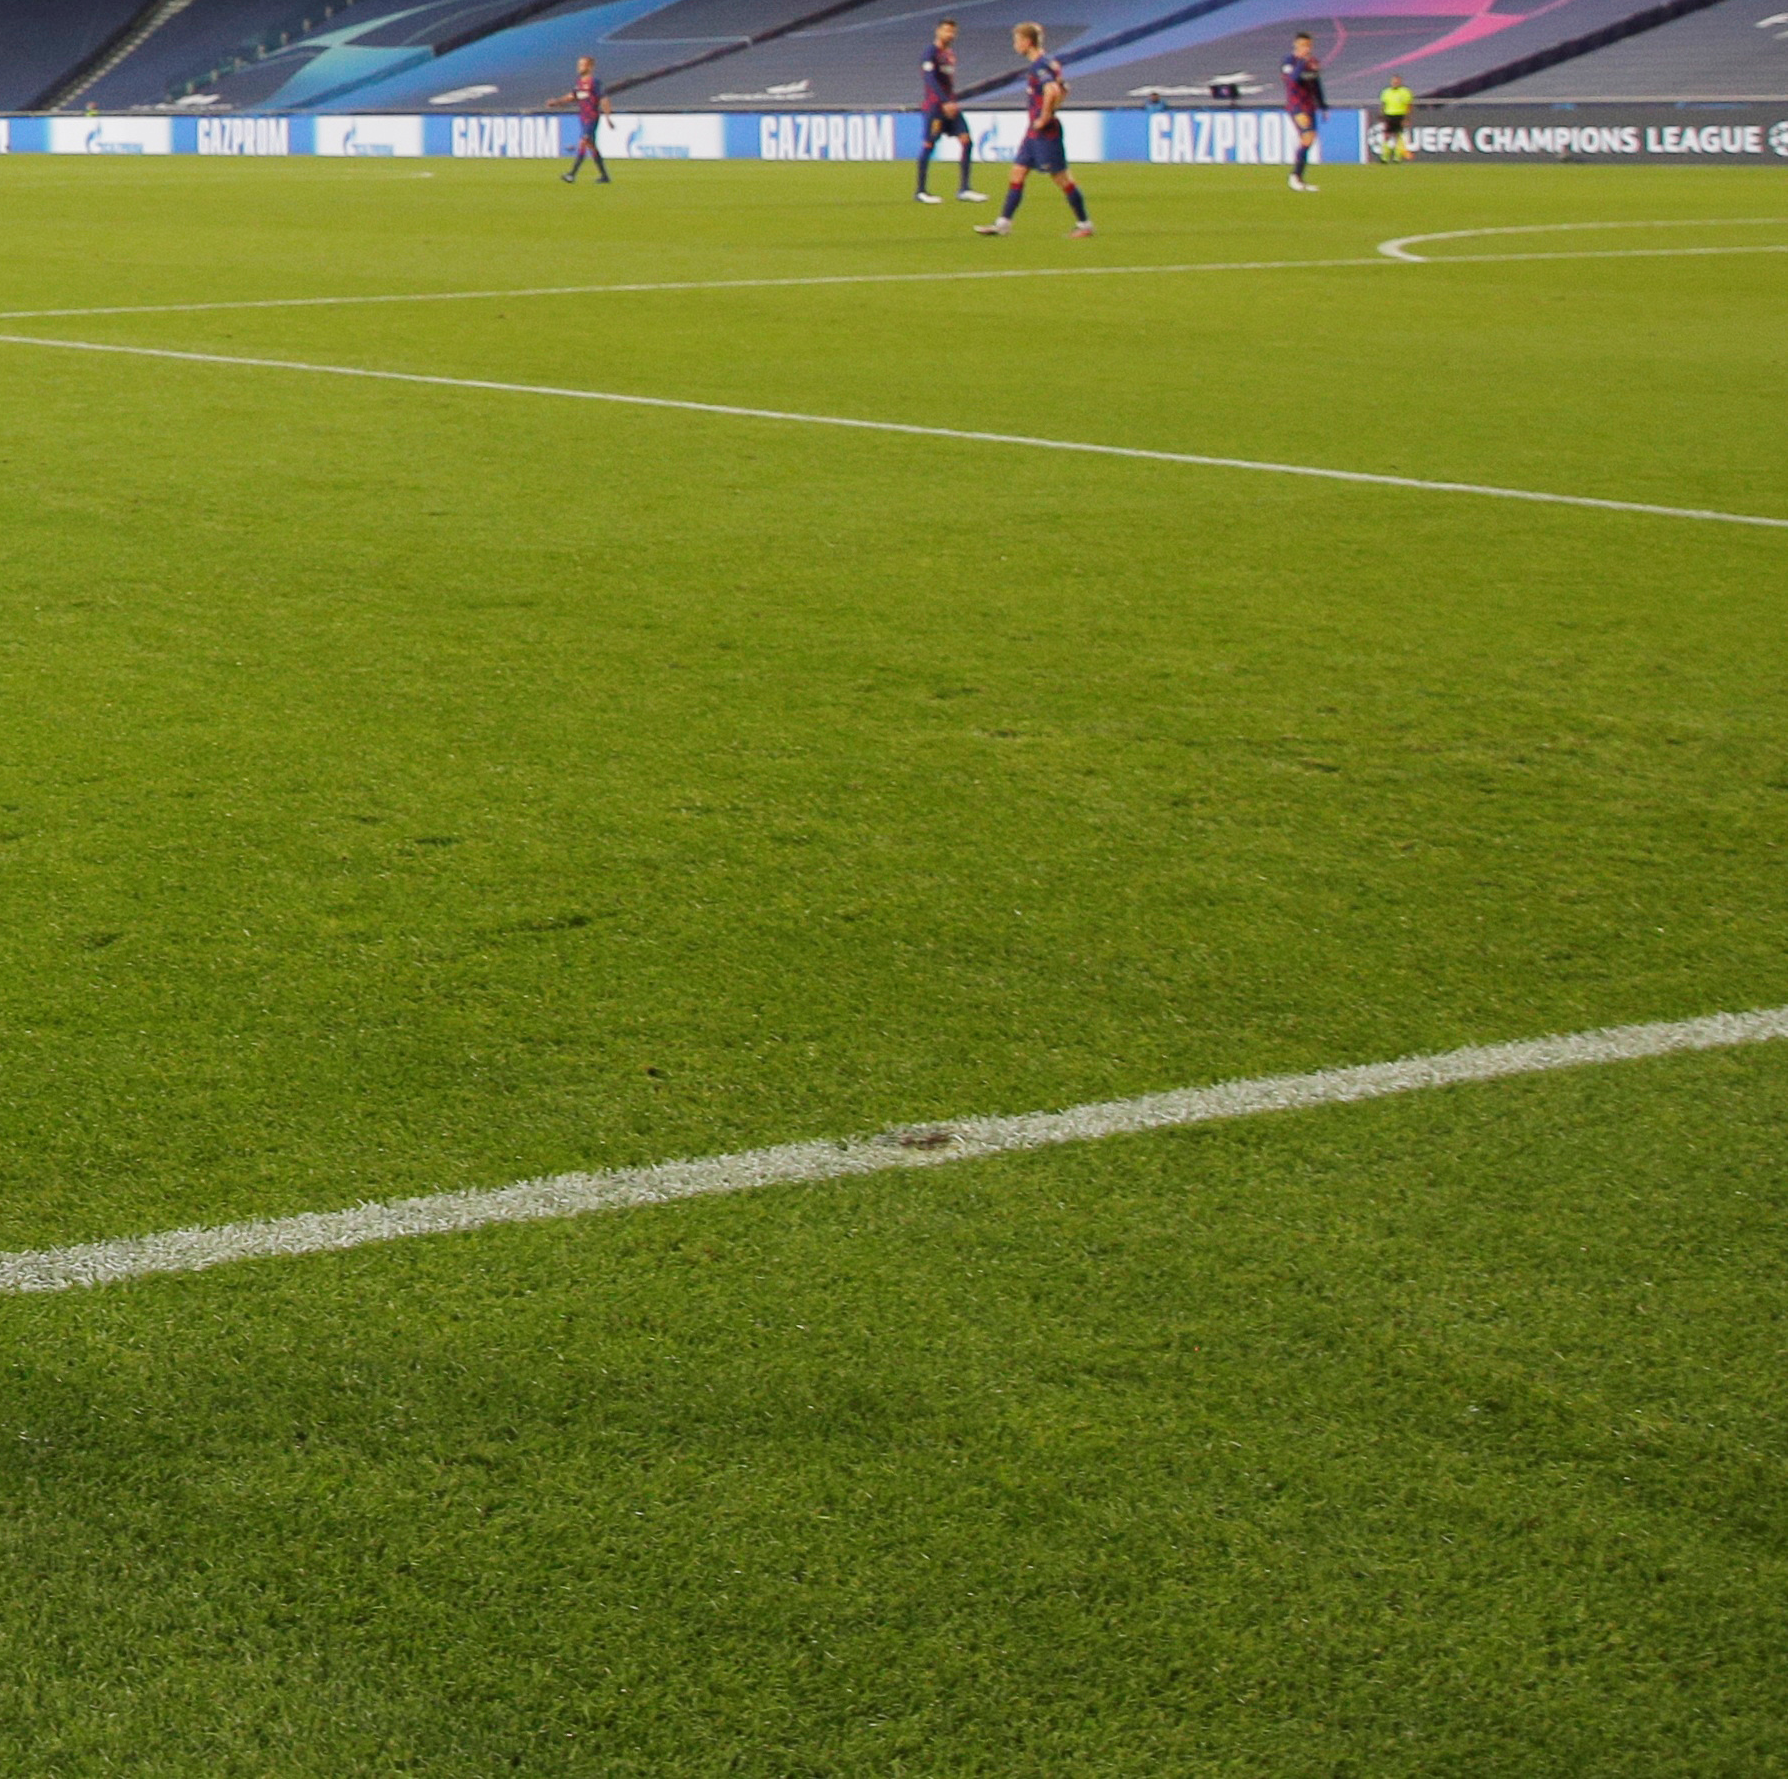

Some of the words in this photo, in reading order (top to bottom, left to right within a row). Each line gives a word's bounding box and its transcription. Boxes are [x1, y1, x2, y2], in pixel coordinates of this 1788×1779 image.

[197, 117, 289, 156] GAZPROM
[451, 116, 561, 157] GAZPROM
[760, 114, 894, 162] GAZPROM
[1406, 126, 1472, 153] UEFA
[1474, 125, 1640, 155] CHAMPIONS
[1645, 125, 1765, 154] LEAGUE
